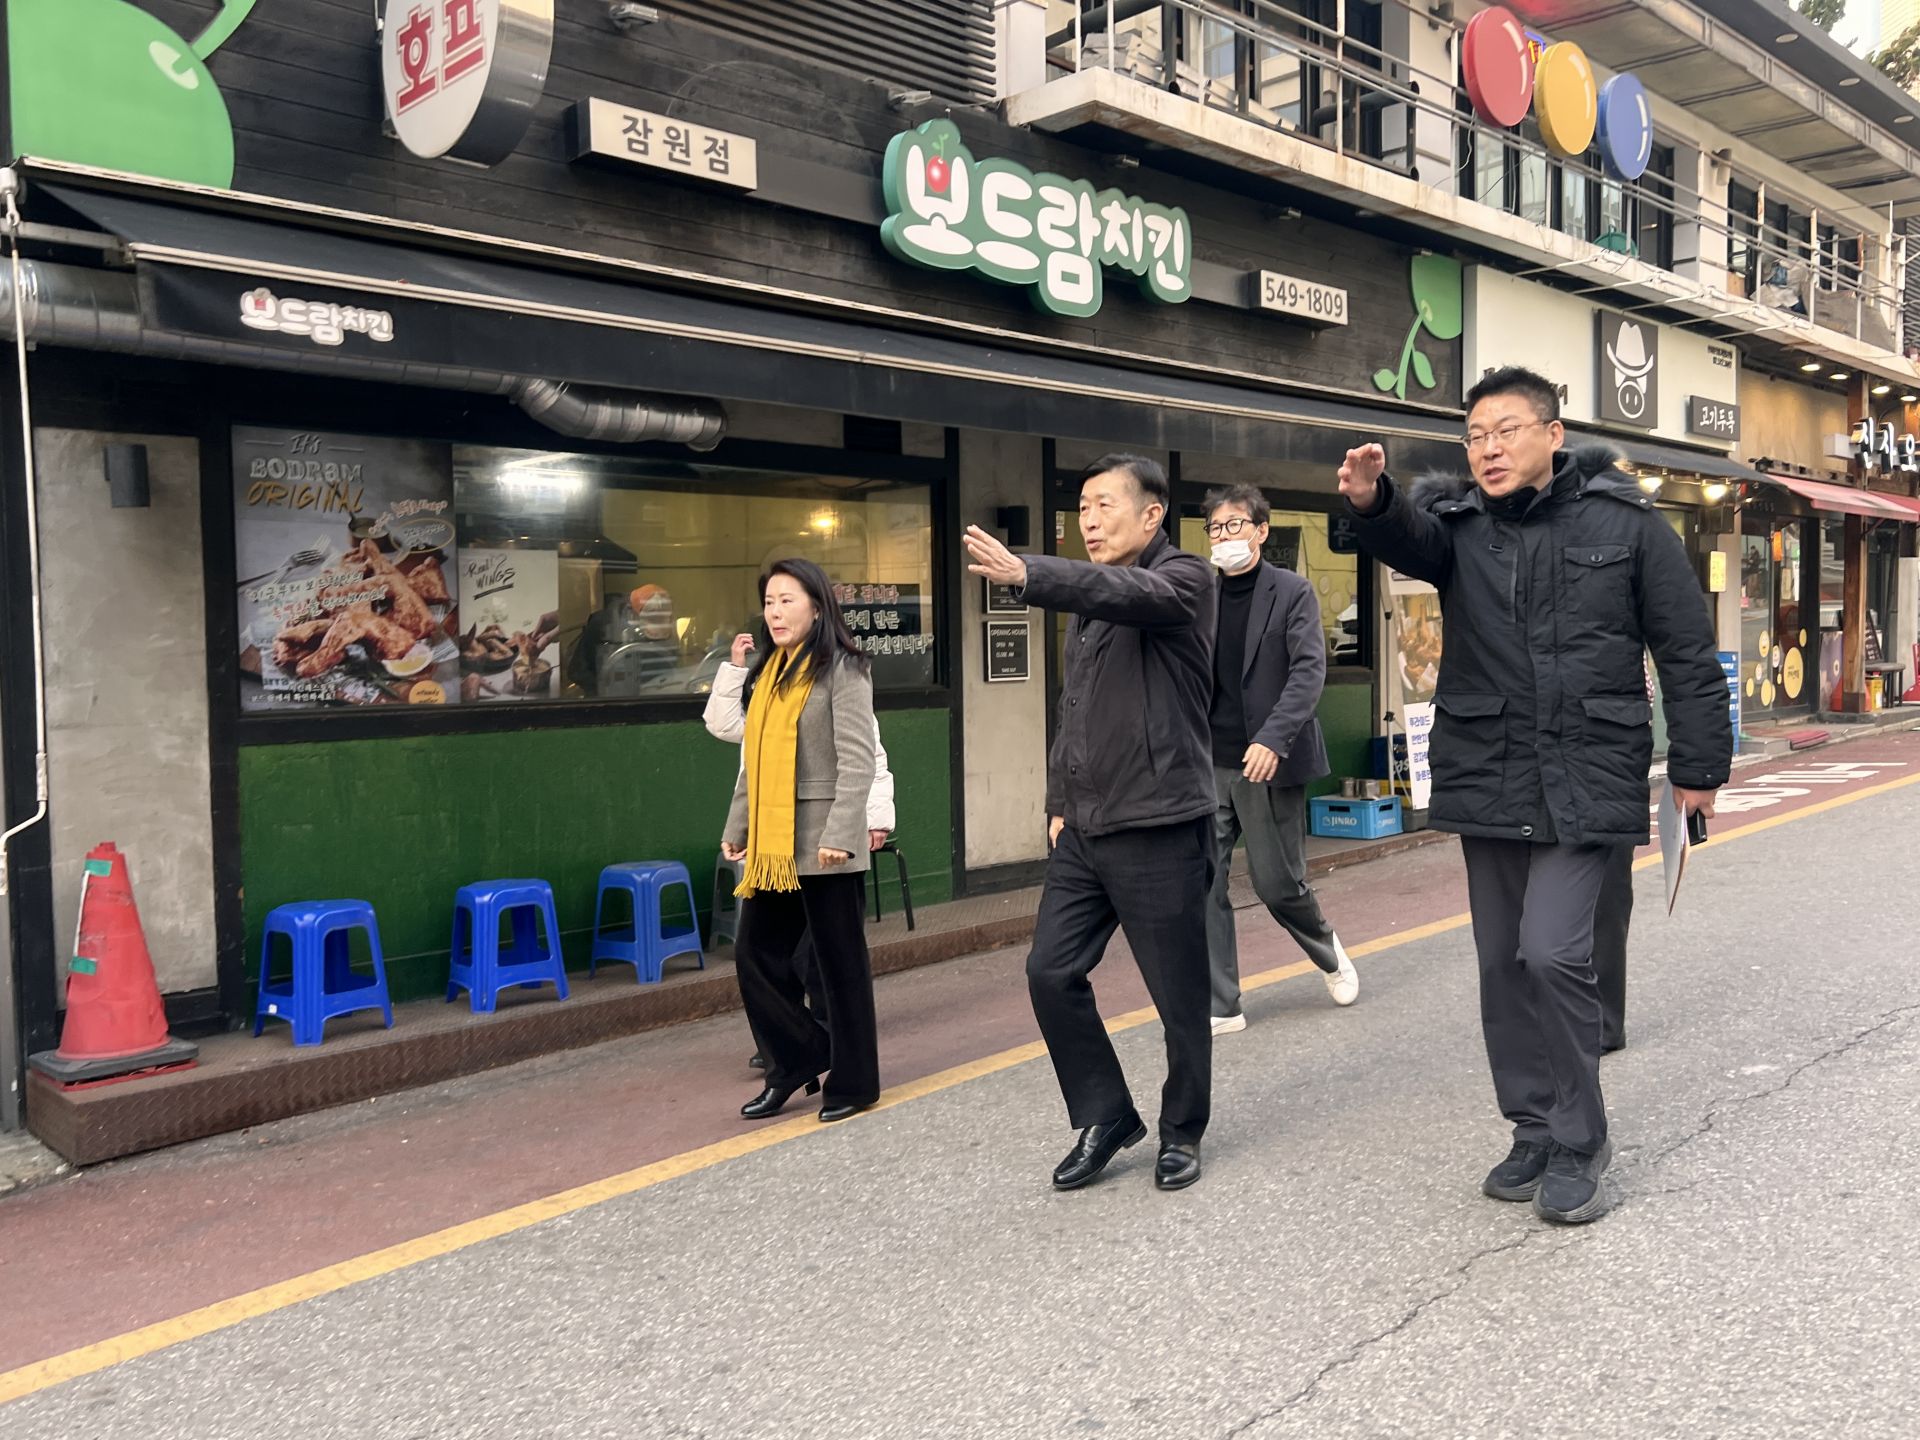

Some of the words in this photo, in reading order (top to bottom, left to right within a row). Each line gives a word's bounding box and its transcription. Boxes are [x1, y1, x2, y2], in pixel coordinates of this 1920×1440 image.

[396, 0, 487, 116] 호프
[620, 113, 732, 176] 잠원점
[899, 140, 1189, 306] 보드람치킨
[1264, 277, 1345, 319] 549-1809
[240, 290, 394, 345] 보드람치킨
[1699, 405, 1736, 434] 고기두목
[289, 432, 323, 455] It's
[246, 480, 365, 514] ORIGINAL
[476, 560, 516, 588] WINGS
[873, 610, 901, 630] 만든
[1331, 815, 1358, 826] JINRO
